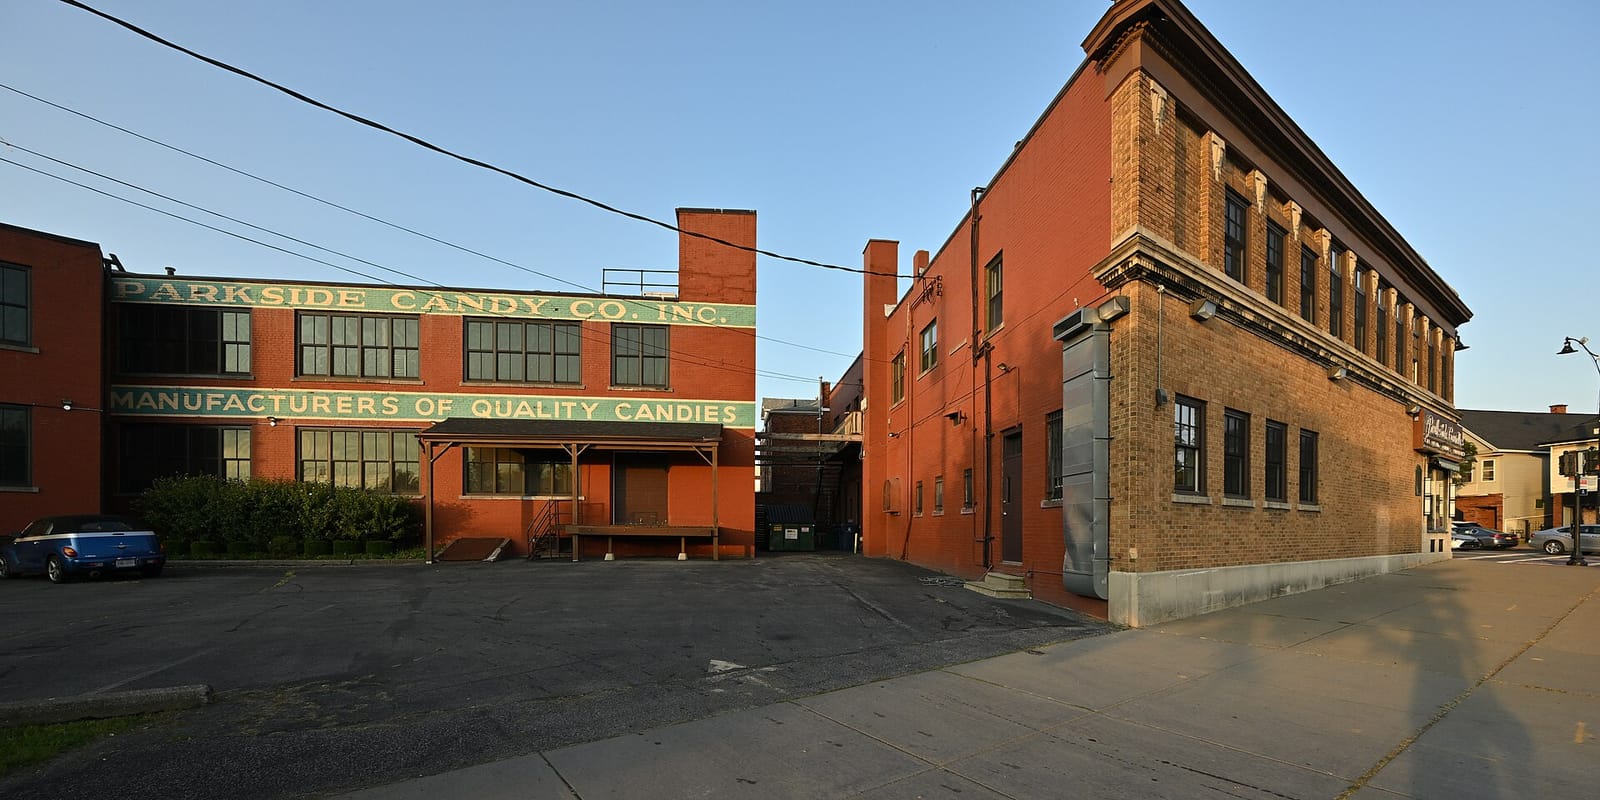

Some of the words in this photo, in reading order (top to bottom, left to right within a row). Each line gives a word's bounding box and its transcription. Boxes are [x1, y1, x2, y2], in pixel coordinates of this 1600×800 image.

[116, 281, 366, 307] PARKSIDE
[390, 292, 550, 315] CANDY
[570, 300, 638, 319] CO.
[657, 304, 727, 323] INC.
[110, 391, 399, 416] MANUFACTURERS
[415, 397, 452, 417] OF
[471, 399, 599, 418] QUALITY
[614, 402, 737, 423] CANDIES
